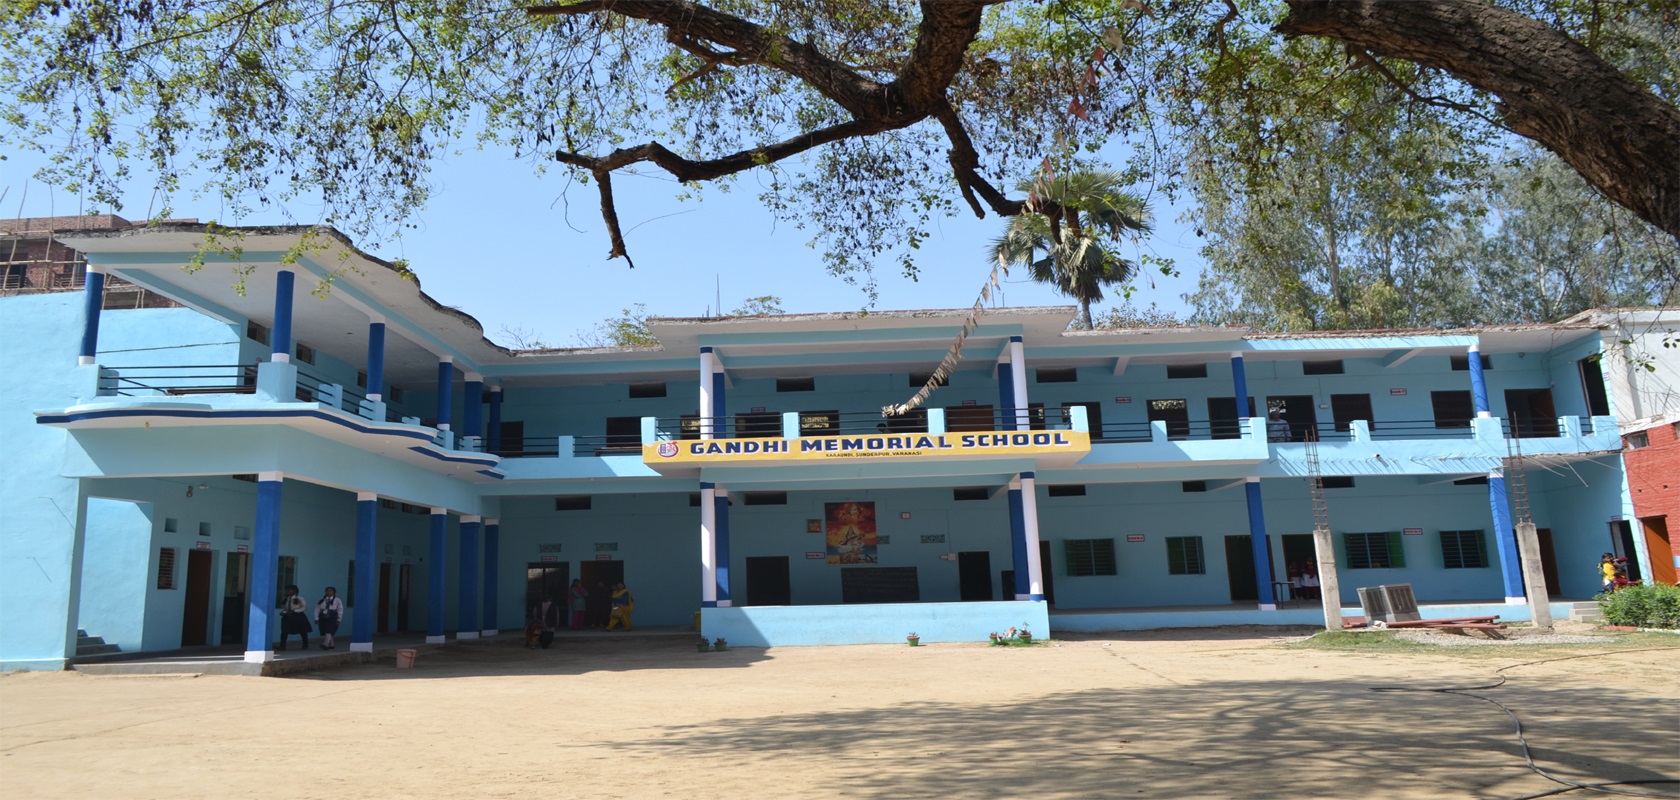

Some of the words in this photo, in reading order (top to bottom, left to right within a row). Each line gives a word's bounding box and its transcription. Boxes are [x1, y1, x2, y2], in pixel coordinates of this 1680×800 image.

[690, 440, 788, 454] GANDHI
[801, 436, 952, 452] MEMORIAL
[962, 433, 1068, 447] SCHOOL
